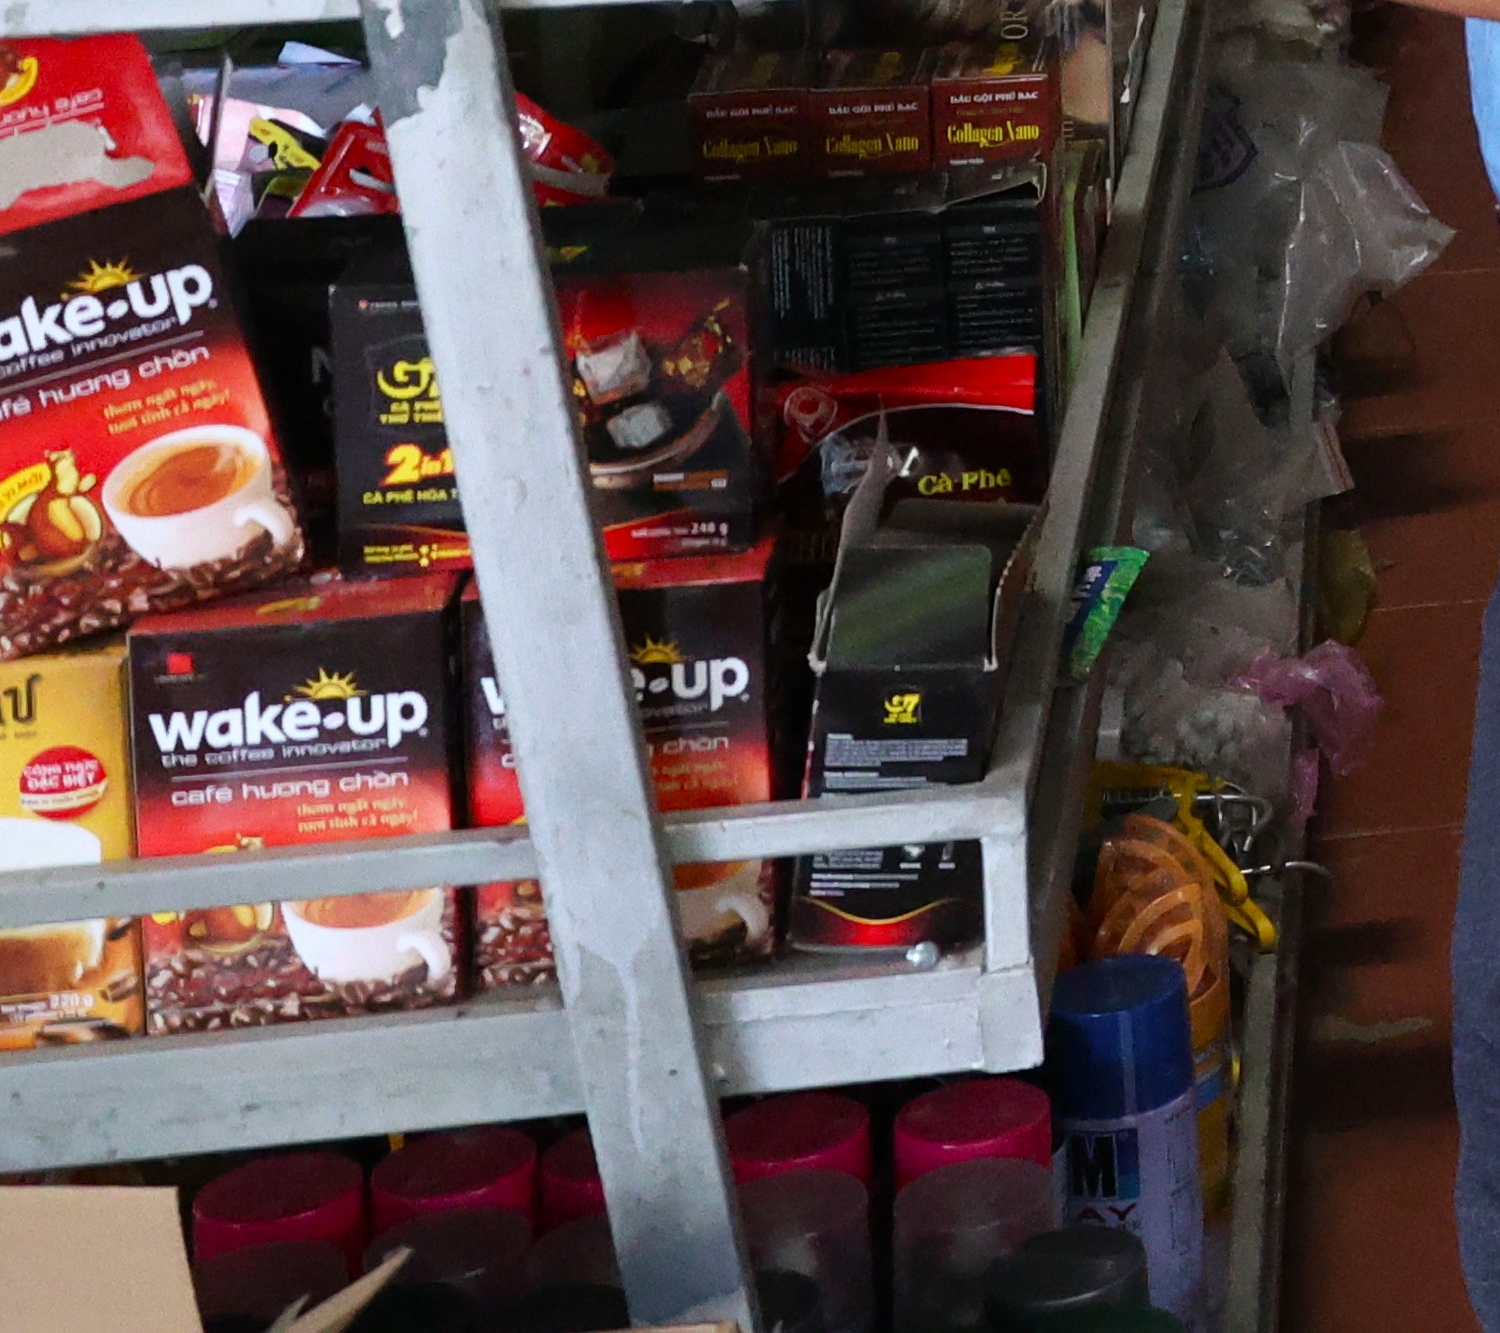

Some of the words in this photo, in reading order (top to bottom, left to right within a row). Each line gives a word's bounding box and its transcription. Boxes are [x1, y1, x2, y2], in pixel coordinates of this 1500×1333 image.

[947, 122, 1003, 148] Collagen
[0, 264, 213, 361] ake-up
[918, 472, 952, 495] Cà
[962, 468, 1011, 490] Phê
[149, 688, 429, 755] wake-up
[161, 750, 201, 768] the
[204, 746, 275, 766] coffee
[282, 738, 391, 759] innovator
[172, 784, 233, 807] café
